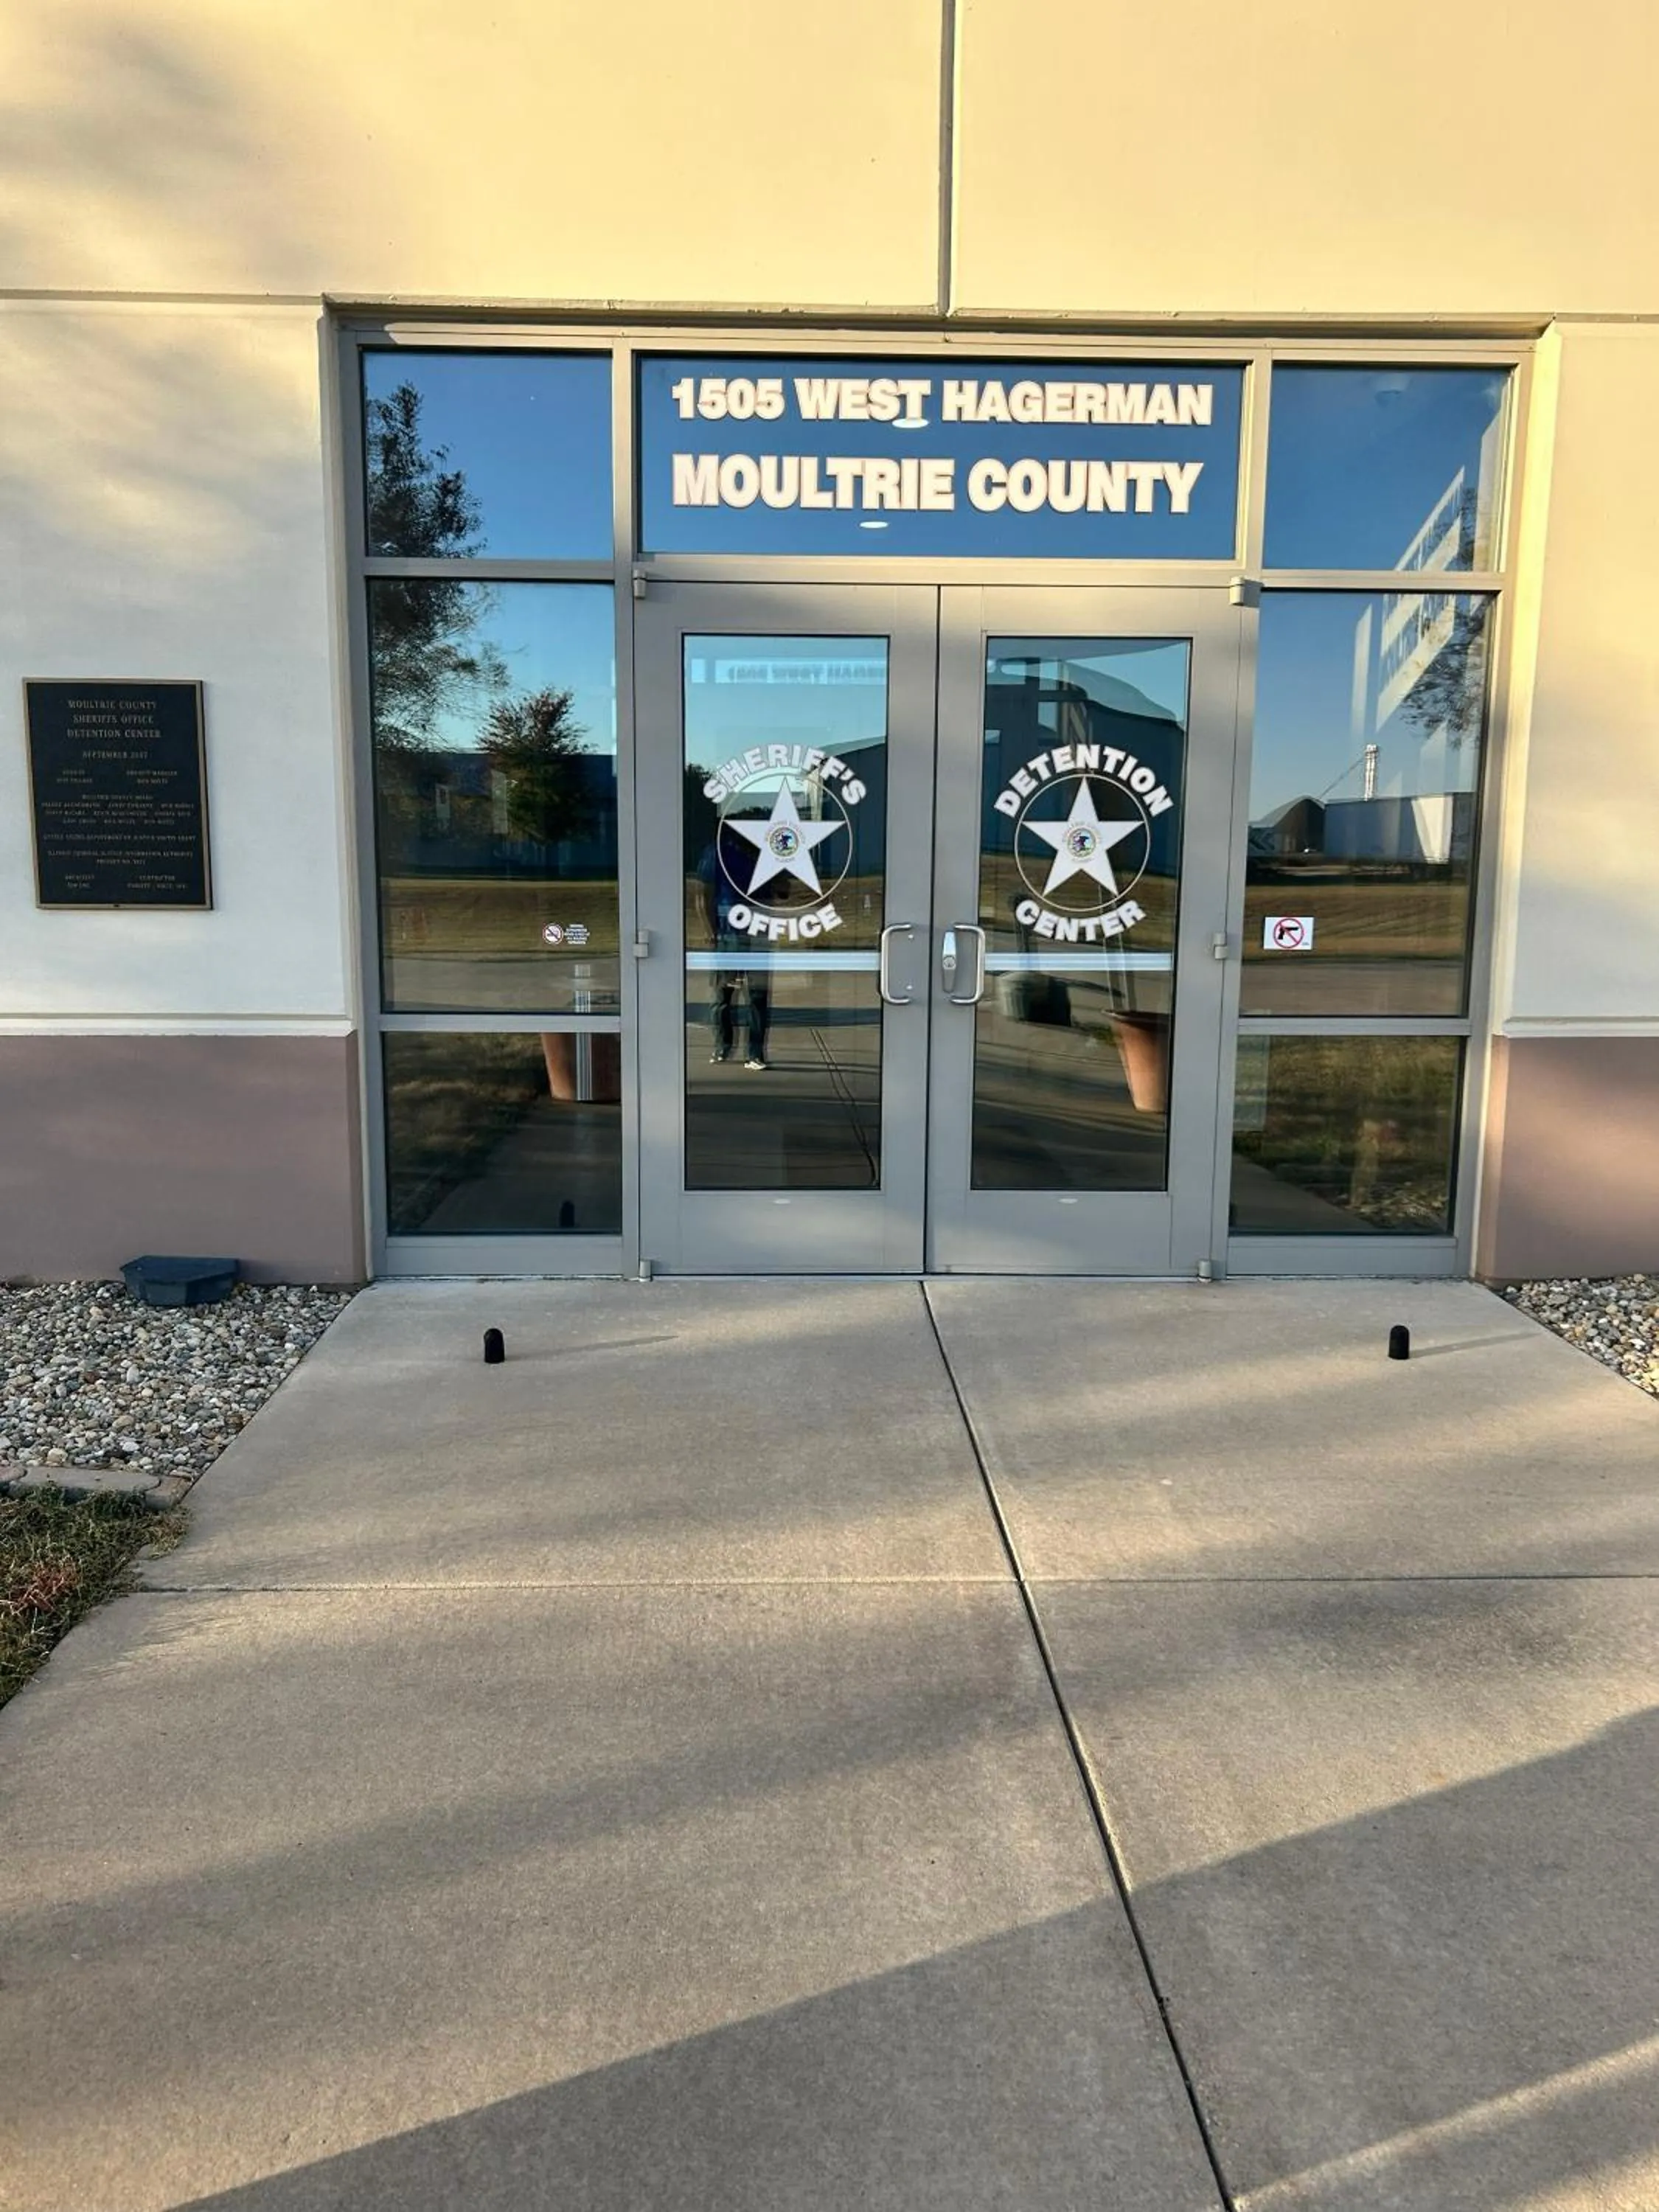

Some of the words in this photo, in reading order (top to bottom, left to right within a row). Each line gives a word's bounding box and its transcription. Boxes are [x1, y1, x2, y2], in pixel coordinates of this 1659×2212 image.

[672, 378, 785, 420] 1505
[793, 378, 931, 421] WEST
[942, 380, 1213, 425] HAGERMAN
[672, 453, 956, 511] MOULTRIE
[967, 458, 1204, 513] COUNTY
[67, 728, 121, 738] DETENTION
[124, 729, 161, 738] CENTER
[121, 715, 154, 724] OFFICE
[703, 743, 867, 806] SHERIFF'S
[993, 743, 1174, 819] DETENTION
[727, 902, 844, 942] OFFICE
[1015, 899, 1147, 943] CENTER
